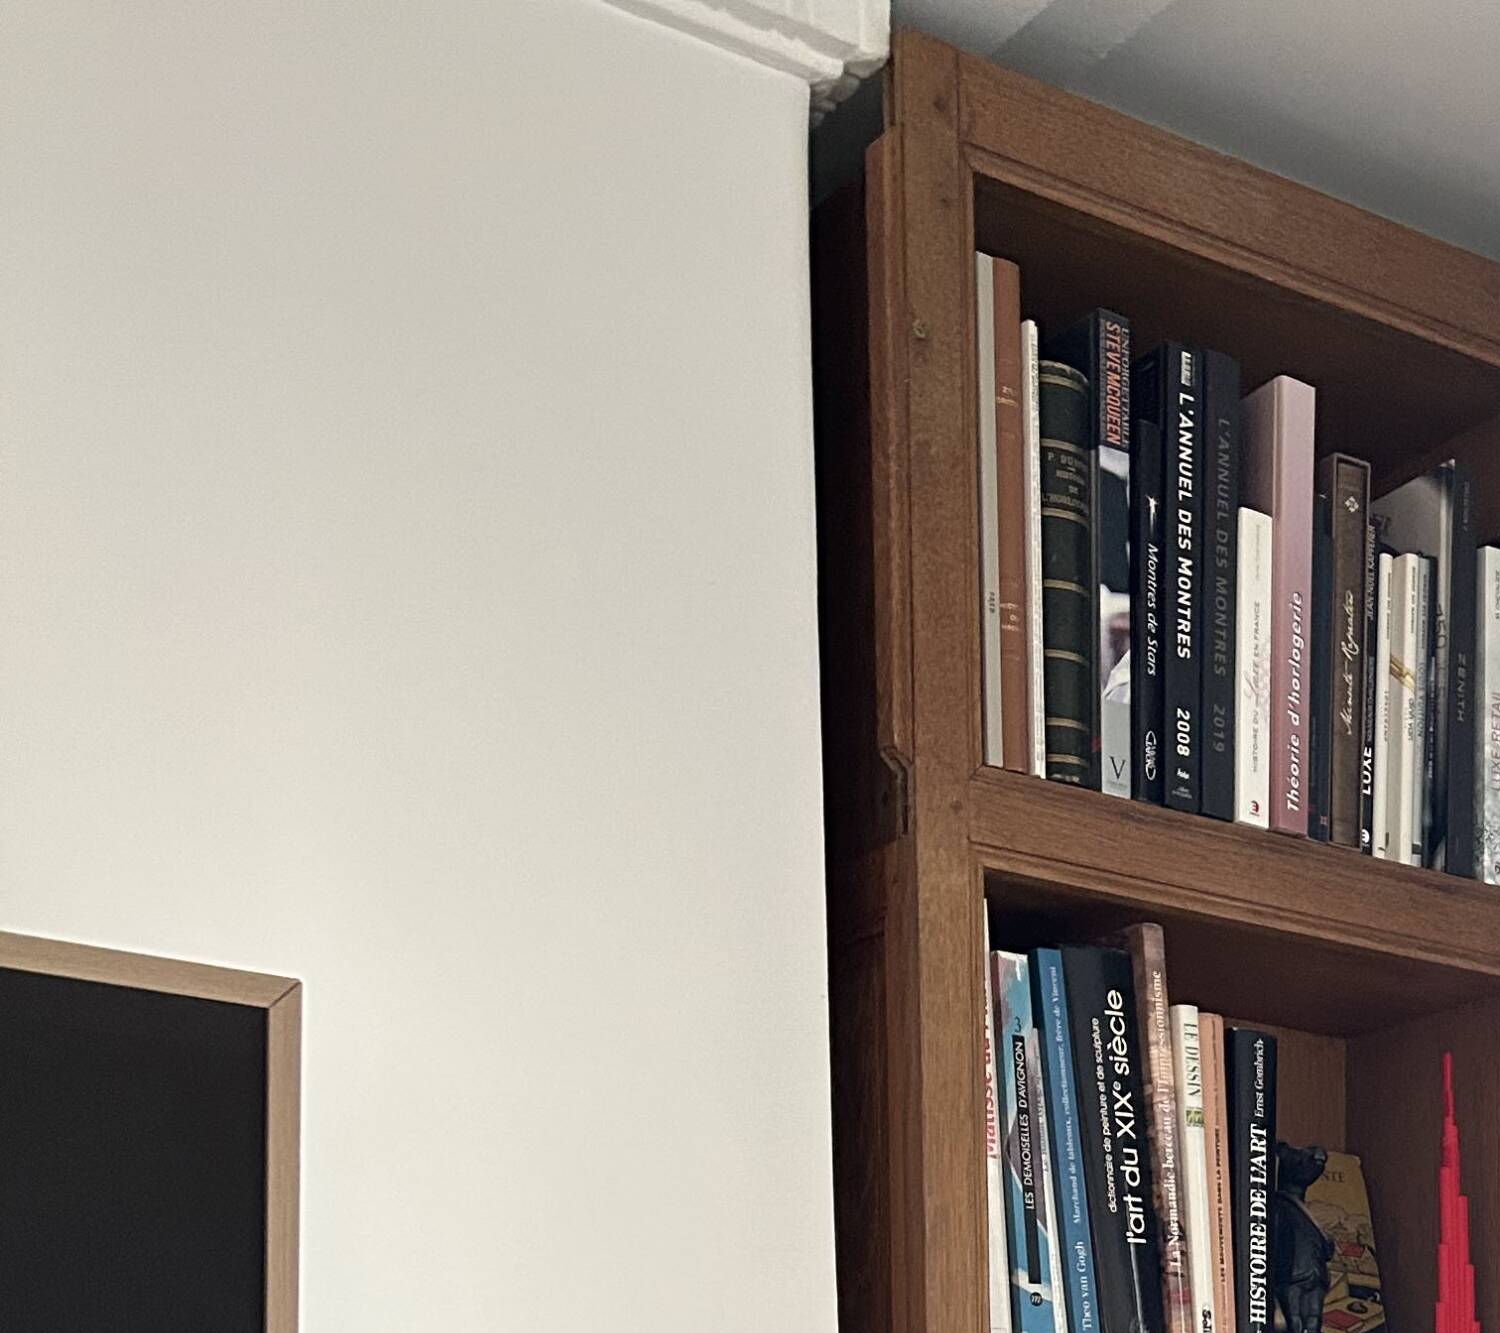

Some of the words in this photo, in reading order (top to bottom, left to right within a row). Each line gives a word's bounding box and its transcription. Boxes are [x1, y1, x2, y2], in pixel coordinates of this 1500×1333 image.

[1177, 393, 1195, 501] L'ANNUEL
[1216, 418, 1231, 523] L'ANNUEL
[1177, 510, 1193, 551] DES
[1215, 529, 1229, 568] DES
[1147, 543, 1159, 609] Montres
[1147, 612, 1157, 630] de
[1177, 557, 1194, 660] MONTRES
[1214, 576, 1228, 677] MONTRES
[1147, 633, 1158, 676] Stars
[1287, 592, 1305, 727] d'horlogerie
[1457, 653, 1467, 723] ZENITH
[1176, 707, 1191, 757] 2008
[1212, 704, 1226, 752] 2019
[1417, 695, 1426, 738] VUITTON
[1286, 734, 1302, 812] Théorie
[1362, 747, 1373, 796] LUXE
[1091, 1017, 1104, 1064] sculpture
[1104, 988, 1130, 1077] siècle
[1183, 1022, 1198, 1040] LE
[1014, 1041, 1028, 1108] D'AVIGNON
[1094, 1065, 1105, 1080] de
[1184, 1045, 1202, 1097] DESSIN
[1254, 1037, 1265, 1090] Gombrich
[1099, 1094, 1112, 1136] peinture
[1254, 1091, 1265, 1119] Ernst
[1018, 1114, 1034, 1187] DEMOISELLES
[1103, 1137, 1112, 1152] de
[1120, 1148, 1141, 1188] du
[1250, 1122, 1267, 1187] L'ART
[1024, 1192, 1035, 1210] LES
[1104, 1153, 1117, 1213] dictionnaire
[1250, 1189, 1267, 1219] DE
[1123, 1193, 1147, 1244] l'art
[1250, 1222, 1267, 1325] HISTOIRE
